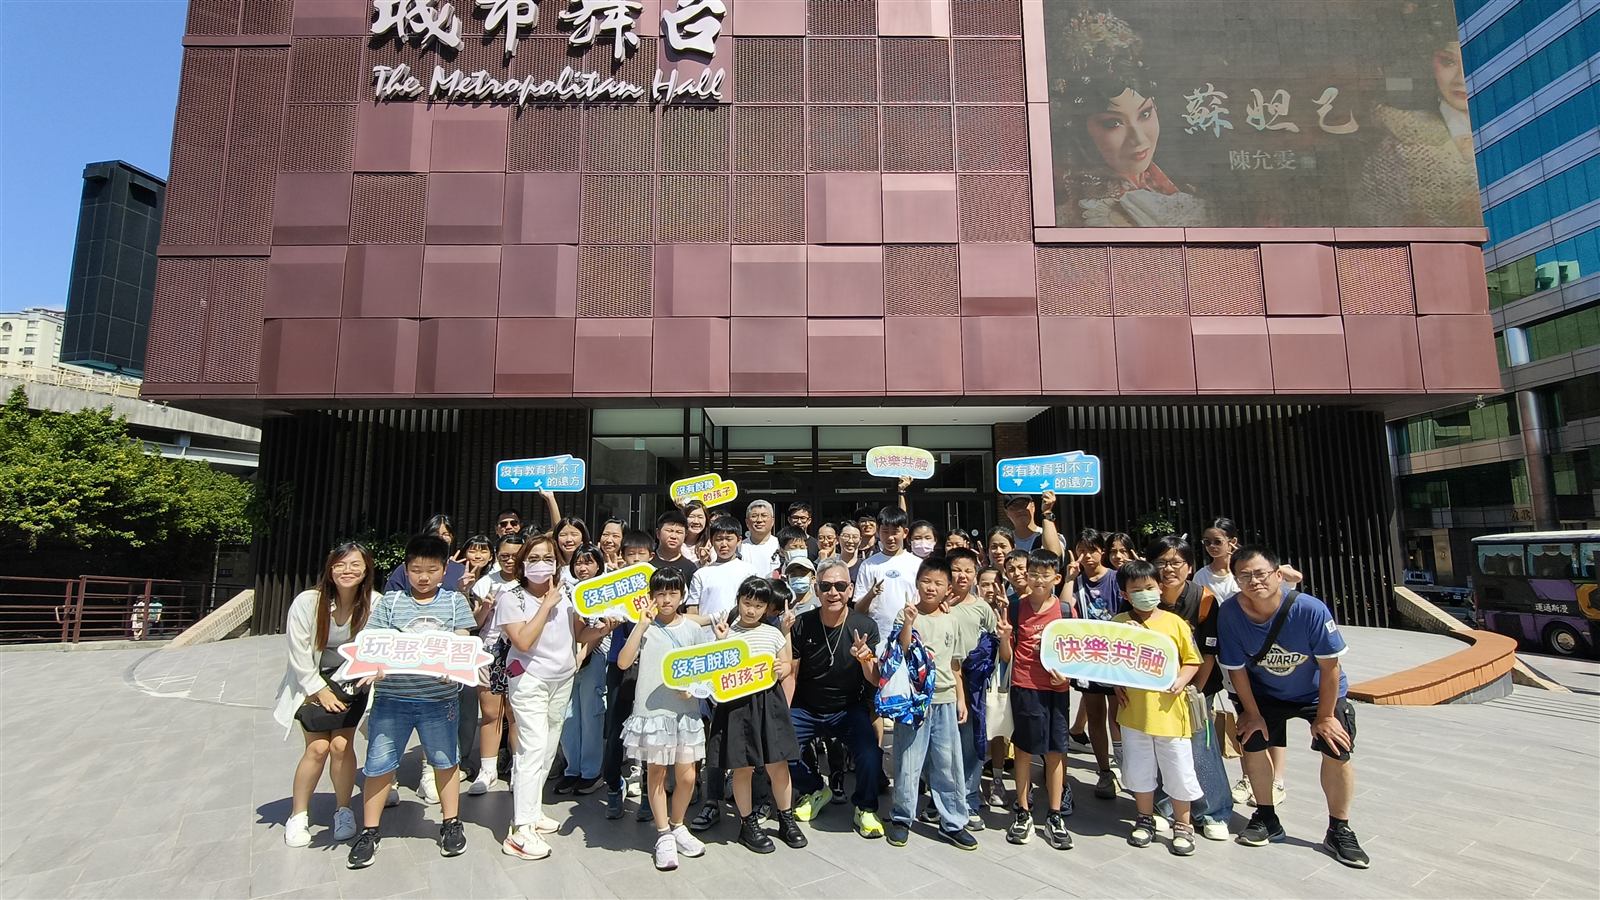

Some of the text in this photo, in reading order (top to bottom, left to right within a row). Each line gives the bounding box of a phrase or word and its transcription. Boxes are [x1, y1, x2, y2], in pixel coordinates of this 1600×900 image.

[374, 64, 726, 107] The Metropolitan Hall
[500, 462, 581, 478] 沒有教育到不了
[873, 453, 929, 472] 快樂共融
[1002, 460, 1094, 478] 沒有教育到不了
[546, 475, 581, 488] 的遠方
[1053, 476, 1094, 489] 的遠方
[703, 486, 731, 502] 的孩子
[362, 635, 475, 664] 玩聚學習
[1056, 635, 1167, 677] 快樂共融
[720, 662, 769, 691] 的孩子
